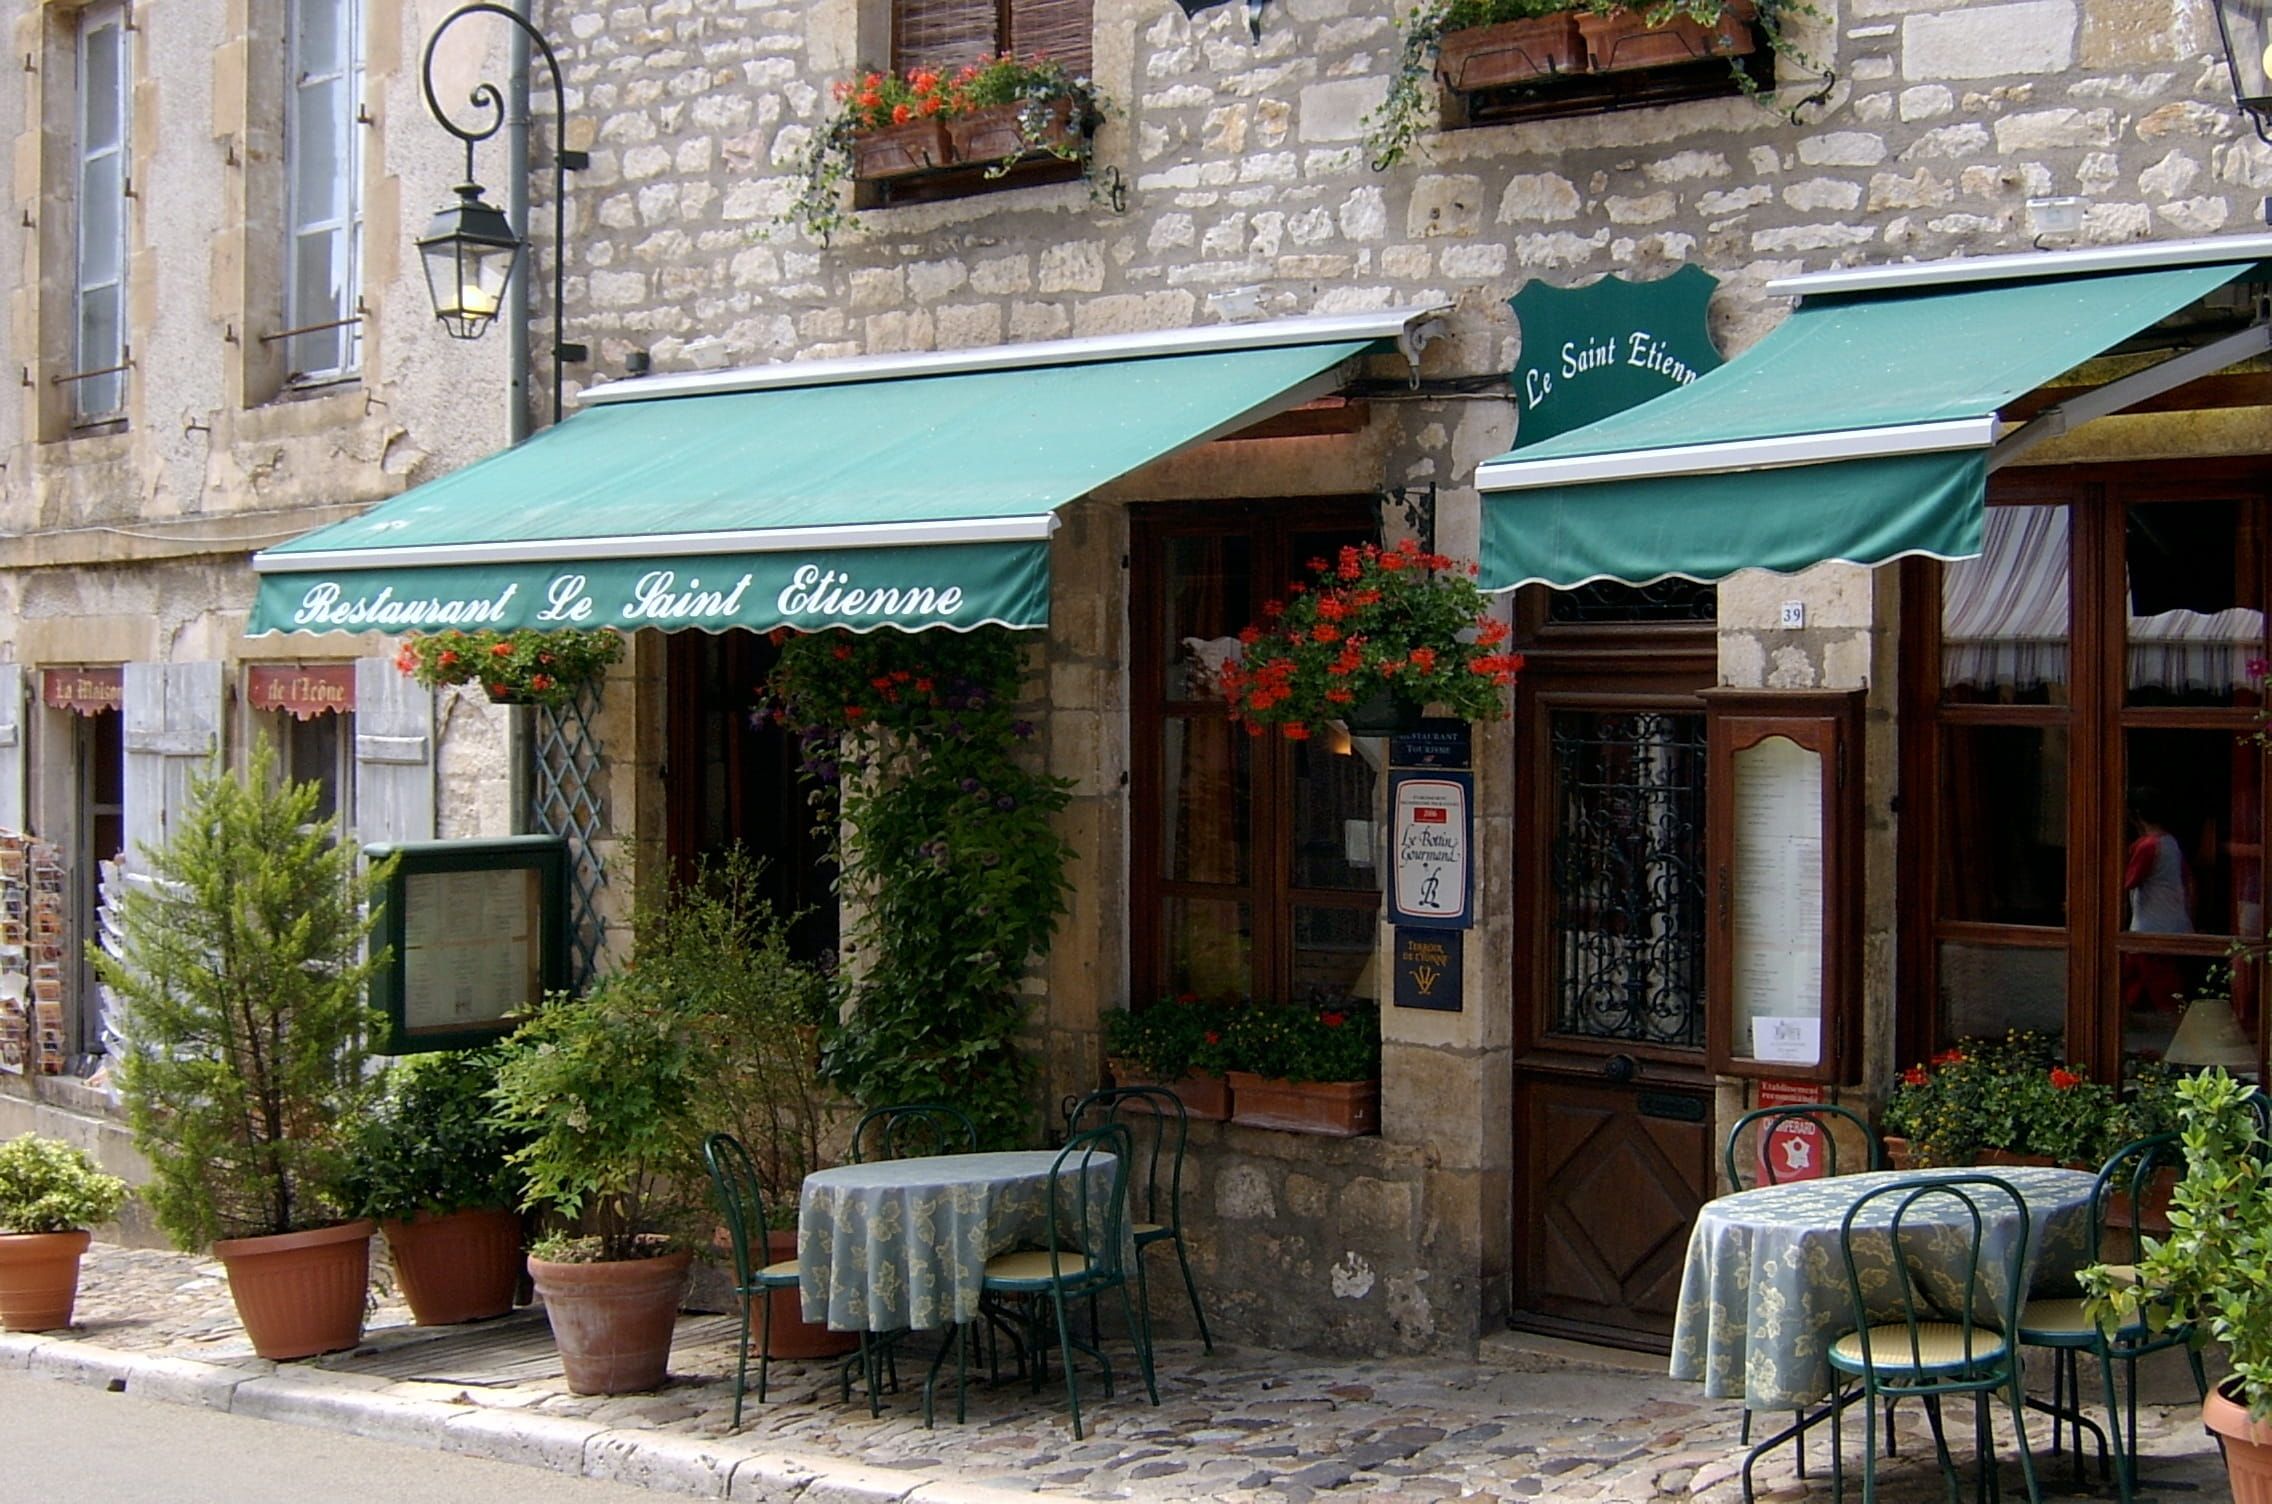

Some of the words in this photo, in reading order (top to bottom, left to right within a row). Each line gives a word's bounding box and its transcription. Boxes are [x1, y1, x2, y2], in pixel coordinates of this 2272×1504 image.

[1525, 368, 1553, 410] Le
[1561, 336, 1616, 379] Saint
[294, 581, 518, 625] Restaurant
[536, 574, 593, 621] Le
[622, 570, 752, 619] Saint
[777, 563, 964, 616] Etienne
[1783, 608, 1801, 622] 39
[55, 678, 73, 700] La
[77, 678, 124, 700] Maison
[268, 677, 284, 701] de
